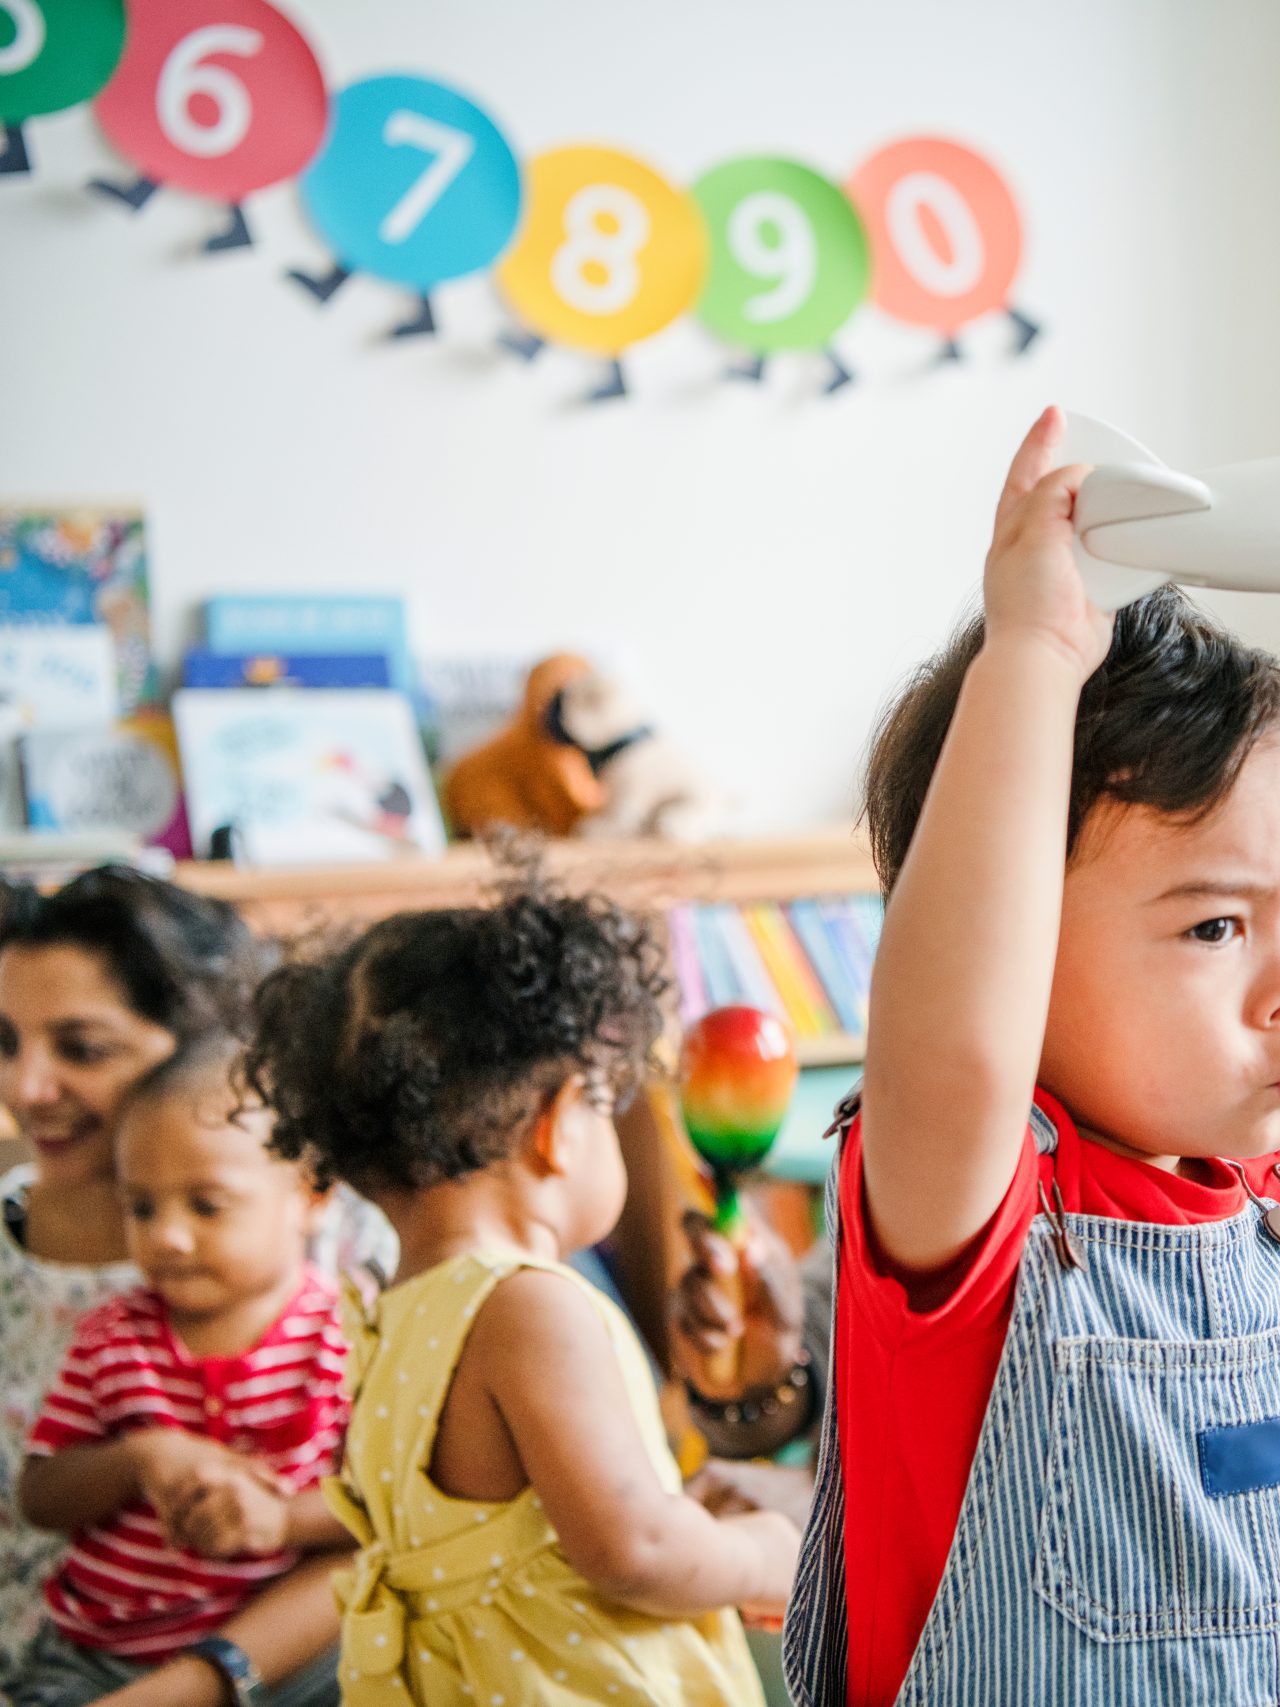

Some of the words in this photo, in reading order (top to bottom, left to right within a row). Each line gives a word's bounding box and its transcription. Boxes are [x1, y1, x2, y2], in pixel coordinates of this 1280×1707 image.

[156, 24, 262, 157] 6
[380, 111, 474, 243] 7
[551, 184, 649, 314] 8
[728, 191, 818, 323] 9
[887, 173, 984, 297] 0
